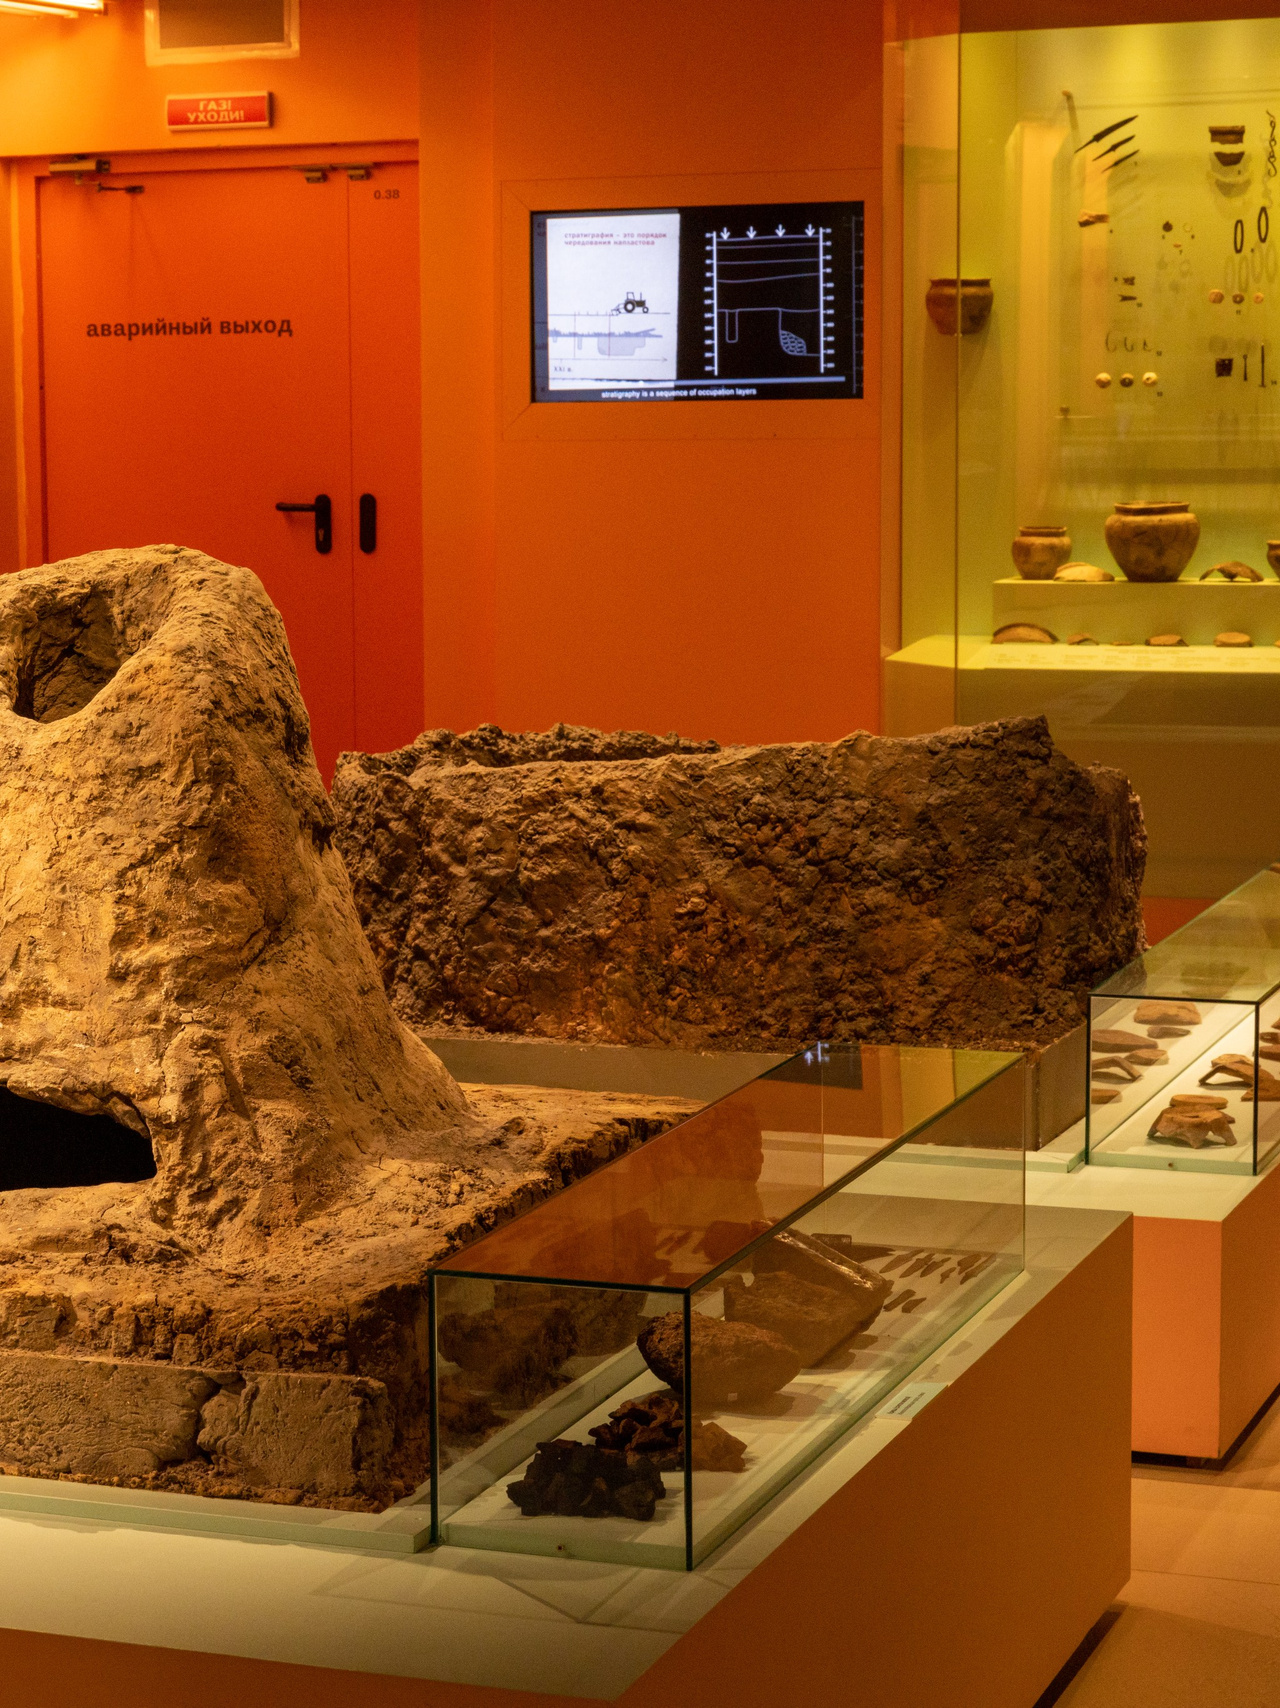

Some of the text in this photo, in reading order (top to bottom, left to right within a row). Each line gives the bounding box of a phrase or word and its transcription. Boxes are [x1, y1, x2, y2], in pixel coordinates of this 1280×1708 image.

[199, 100, 231, 111] ГАЗ!
[187, 110, 244, 122] УХОДИ!
[373, 189, 400, 200] 0.38
[85, 317, 293, 341] аварийный выход
[601, 389, 641, 399] stratigraphy
[698, 388, 734, 397] occupation
[736, 388, 757, 397] layers
